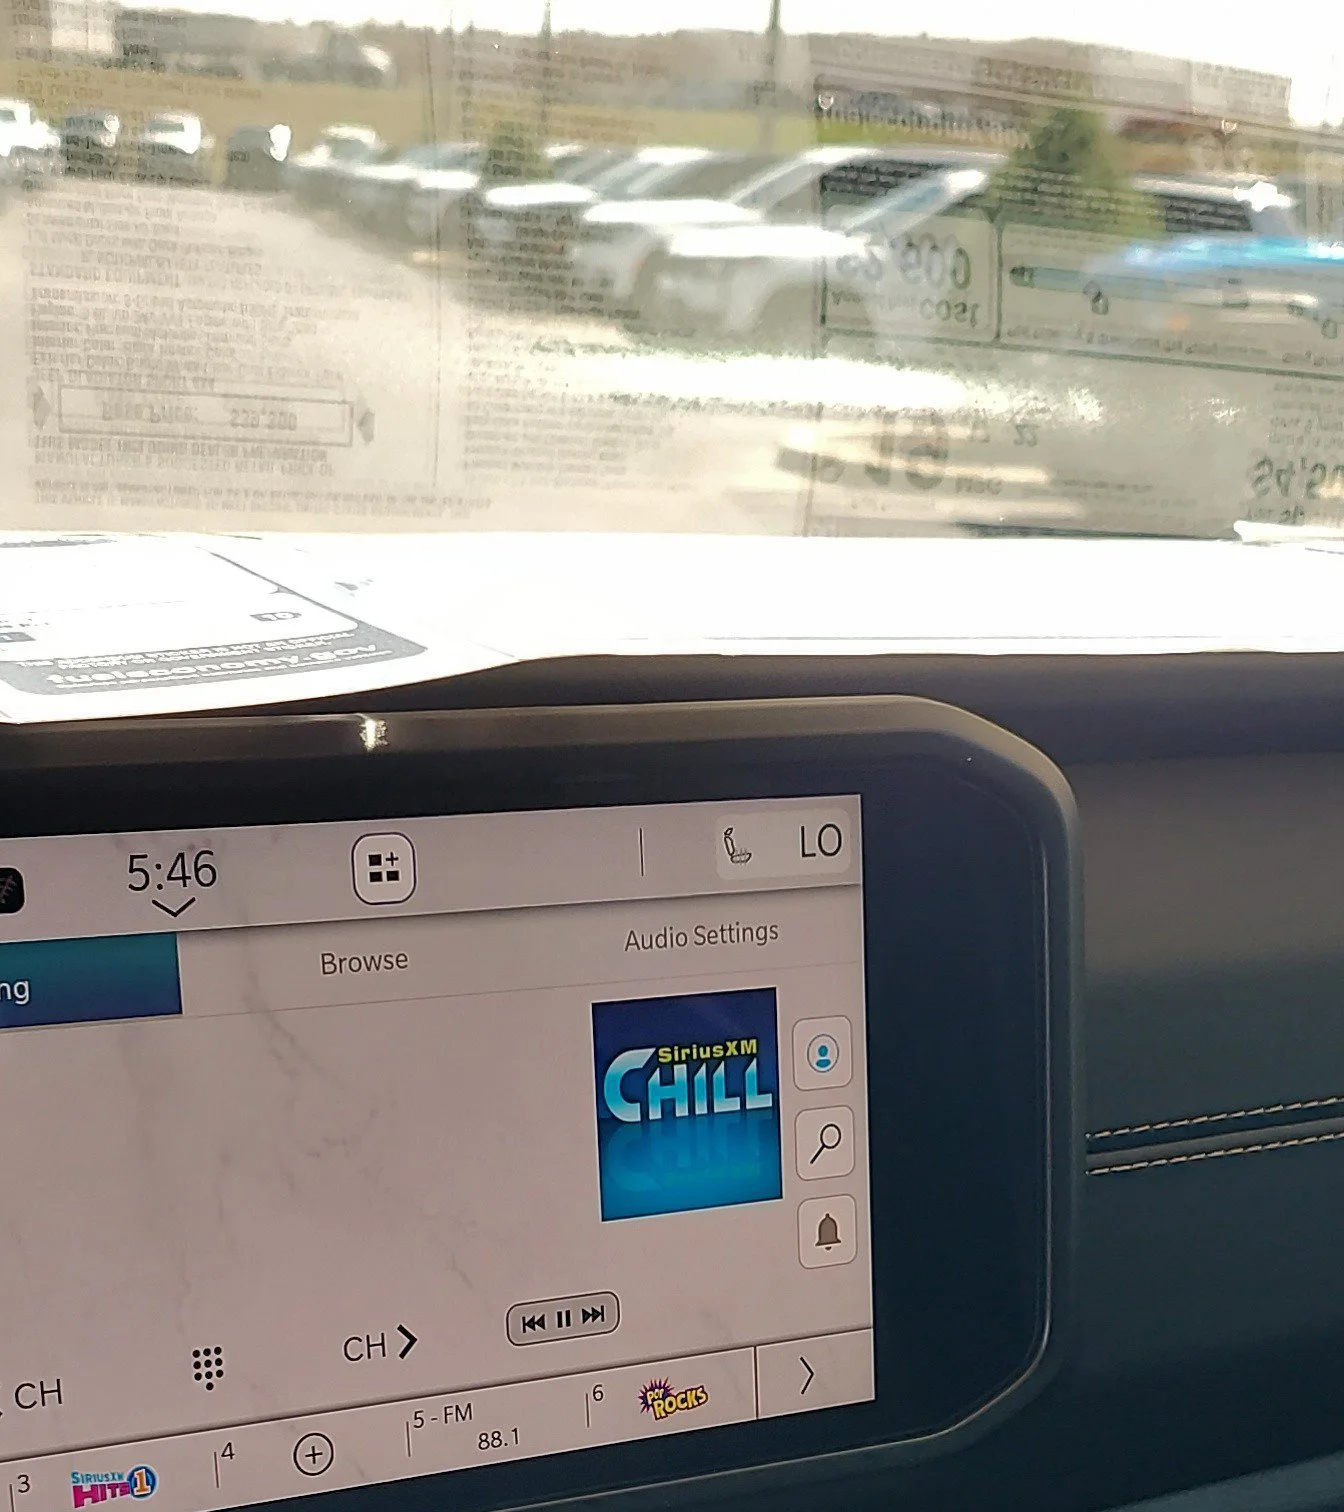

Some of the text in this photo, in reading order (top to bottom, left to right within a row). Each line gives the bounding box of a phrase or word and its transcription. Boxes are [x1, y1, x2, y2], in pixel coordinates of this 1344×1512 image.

[800, 823, 843, 858] LO
[127, 850, 218, 893] 5:46
[624, 920, 780, 953] Audio Settings
[320, 950, 409, 976] Browse
[658, 1038, 758, 1064] SiriusXM
[603, 1047, 774, 1123] CHILL
[343, 1332, 387, 1363] CH
[14, 1379, 64, 1410] CH
[592, 1384, 604, 1403] 6
[653, 1388, 707, 1418] ROCKS
[443, 1404, 474, 1425] FM
[220, 1442, 236, 1462] 4
[477, 1428, 521, 1452] 88.1
[17, 1475, 31, 1494] 3
[72, 1482, 131, 1508] HITS
